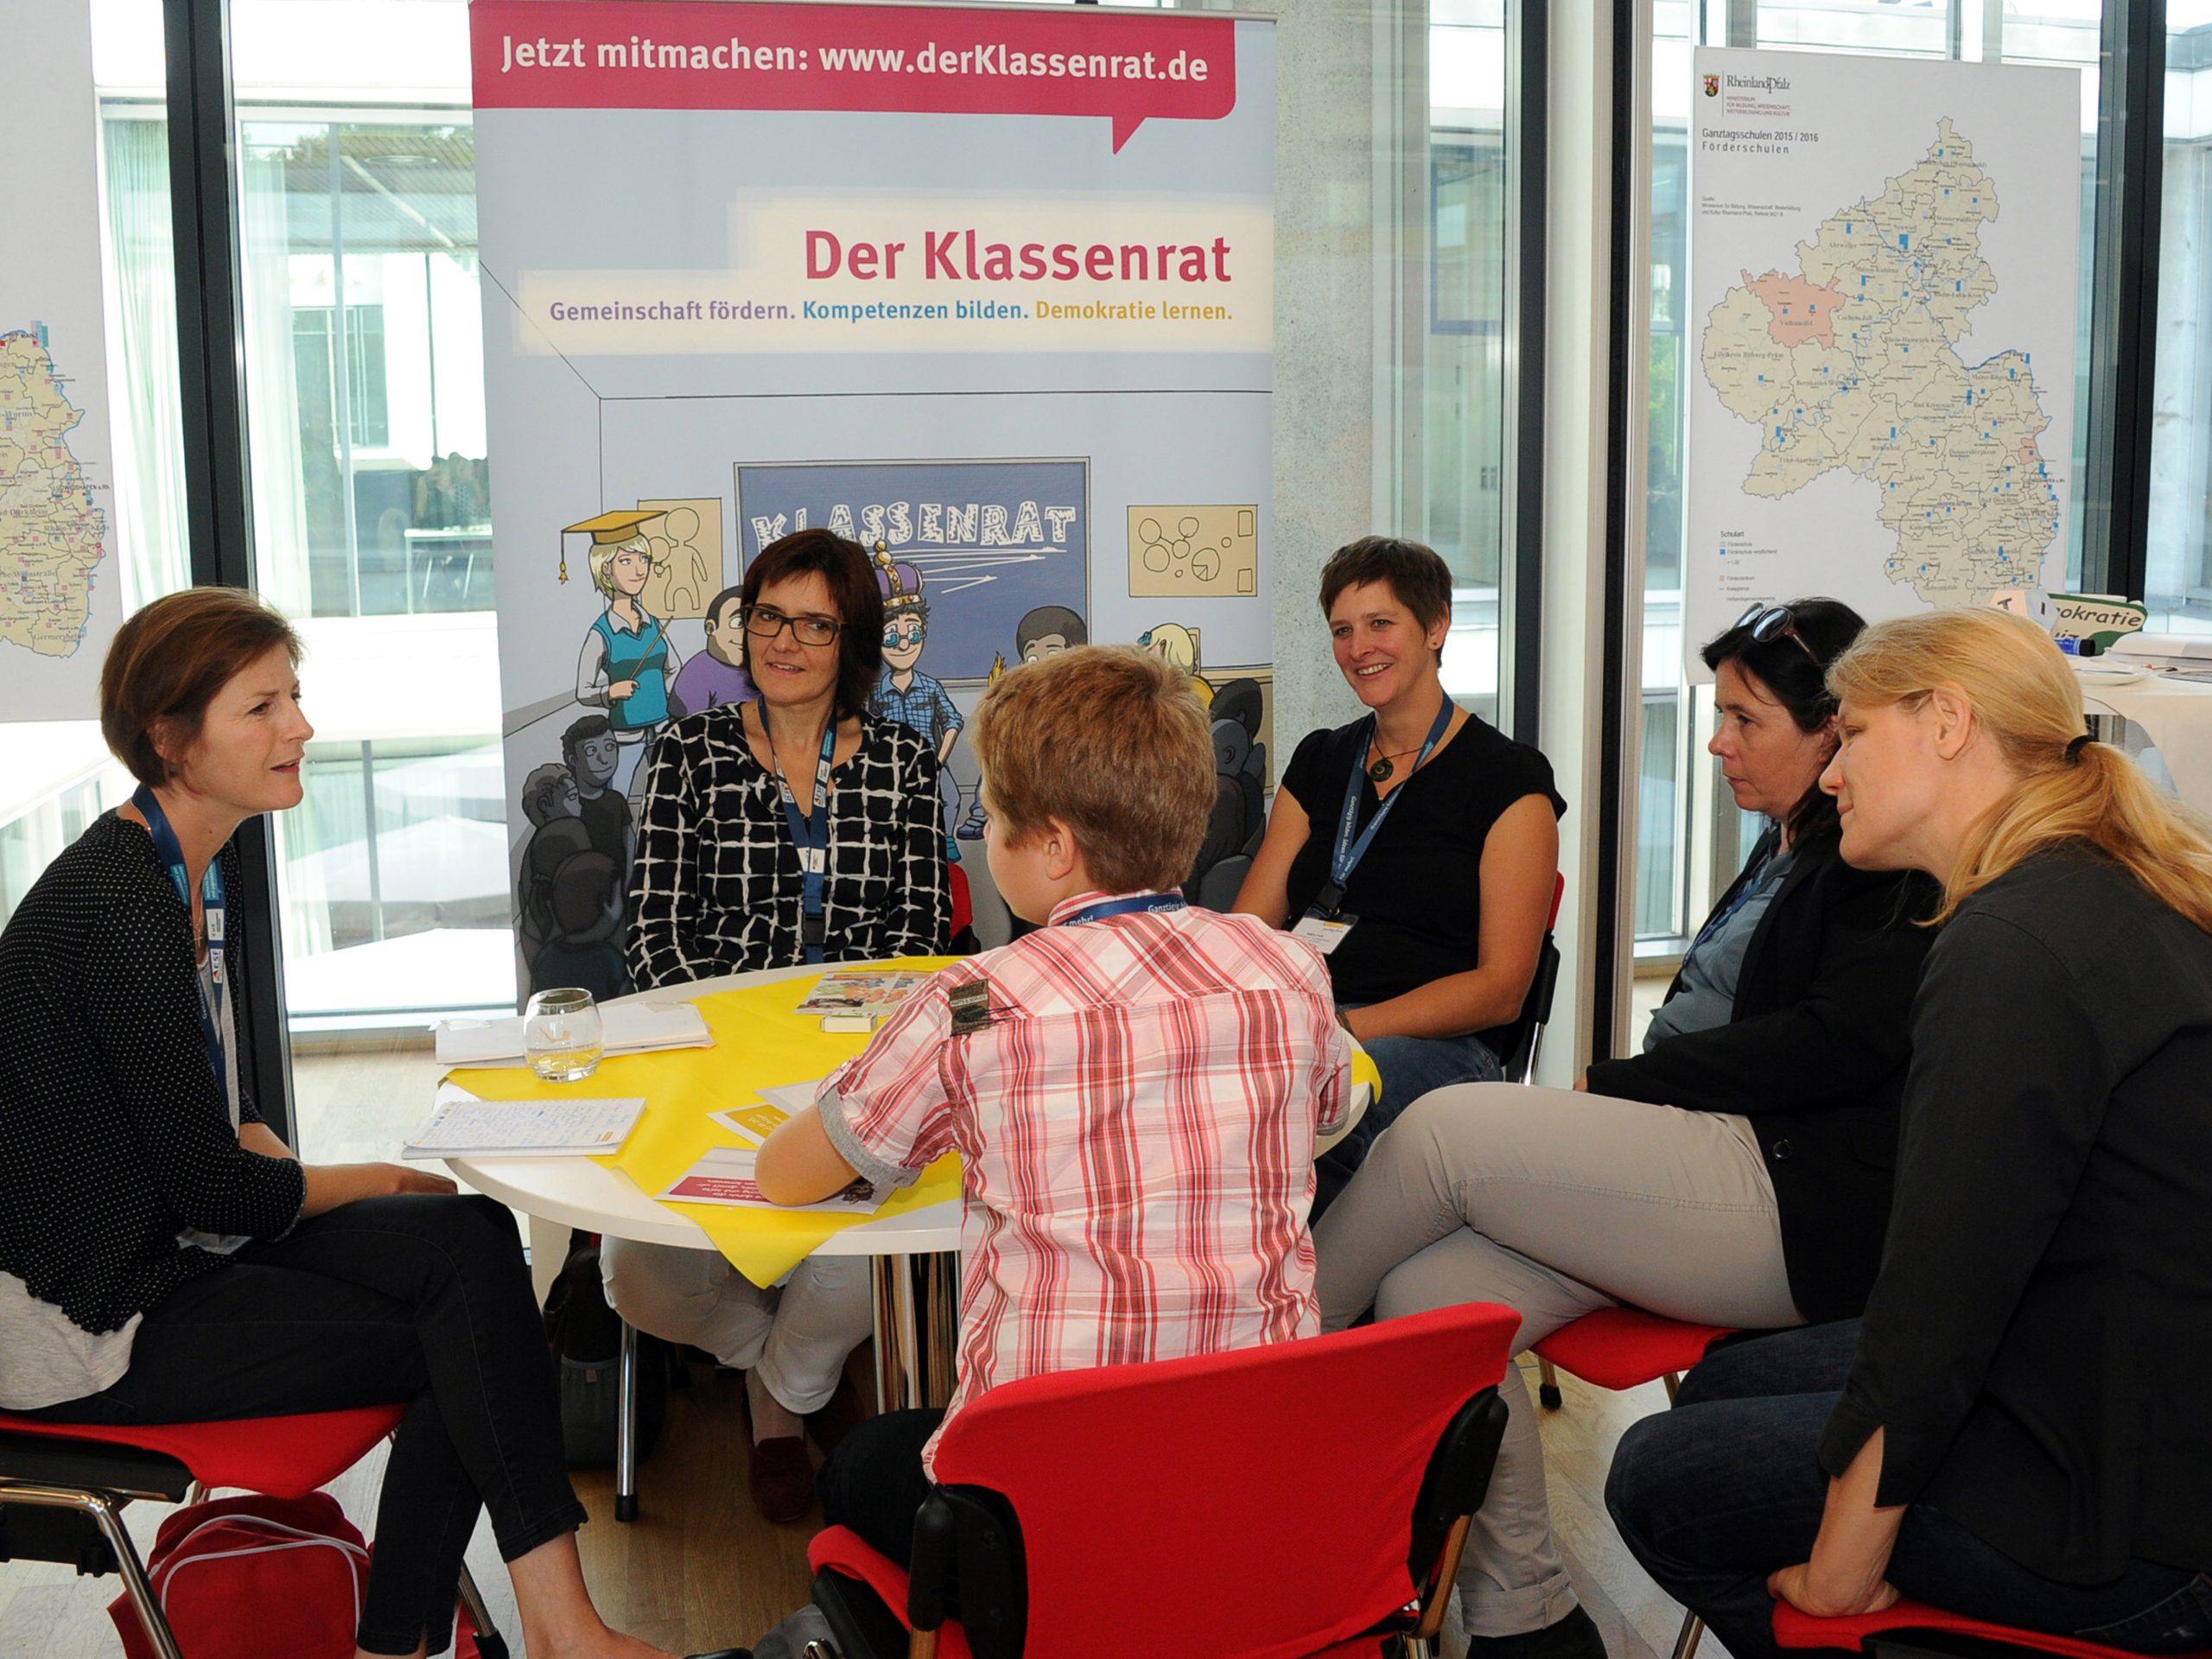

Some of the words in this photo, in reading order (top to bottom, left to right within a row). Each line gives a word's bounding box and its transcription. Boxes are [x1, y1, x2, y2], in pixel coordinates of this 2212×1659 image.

[502, 36, 586, 74] Jetzt
[598, 36, 809, 72] mitmachen:
[819, 42, 1209, 82] www.derKlassenrat.de
[1701, 128, 1772, 141] Ganztagsschulen
[1774, 131, 1794, 141] 2015
[1800, 132, 1819, 143] 2016
[1701, 141, 1789, 154] Förderschulen
[808, 232, 906, 281] Der
[926, 230, 1232, 283] Klassenrat
[550, 300, 703, 322] Gemeinschaft
[709, 300, 797, 321] fördern.
[804, 301, 949, 325] Kompetenzen
[956, 301, 1029, 320] bilden.
[1036, 301, 1157, 321] Demokratie
[1163, 301, 1233, 322] lernen.
[751, 501, 1076, 553] KLASSENRAT
[2056, 605, 2141, 627] okratie
